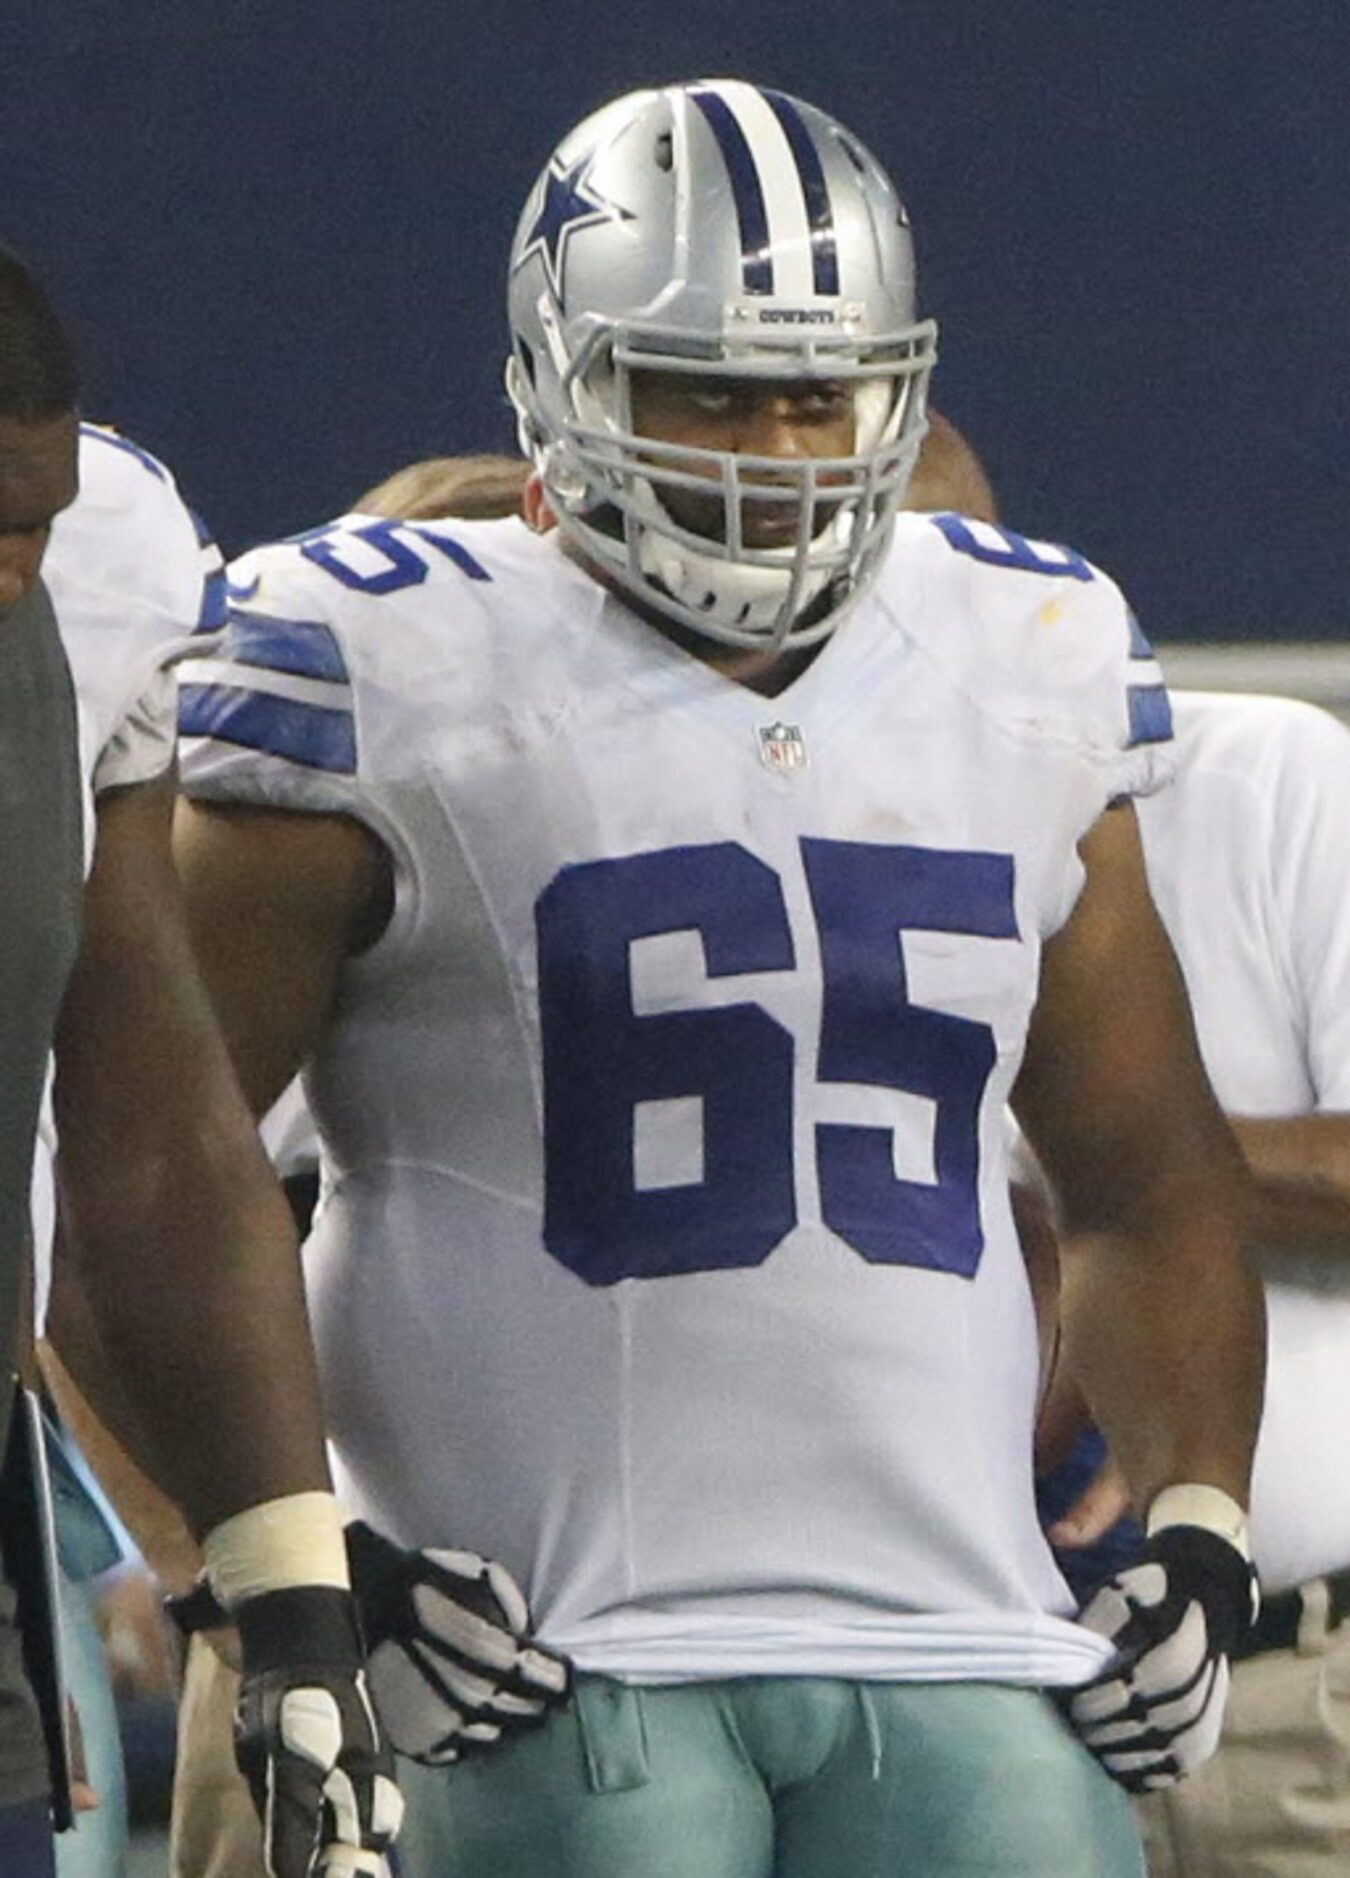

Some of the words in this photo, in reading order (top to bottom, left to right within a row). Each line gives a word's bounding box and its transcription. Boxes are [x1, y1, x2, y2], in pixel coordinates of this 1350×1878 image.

[759, 308, 834, 324] COWBOYS
[766, 742, 805, 767] NFL
[534, 835, 1023, 1288] 65
